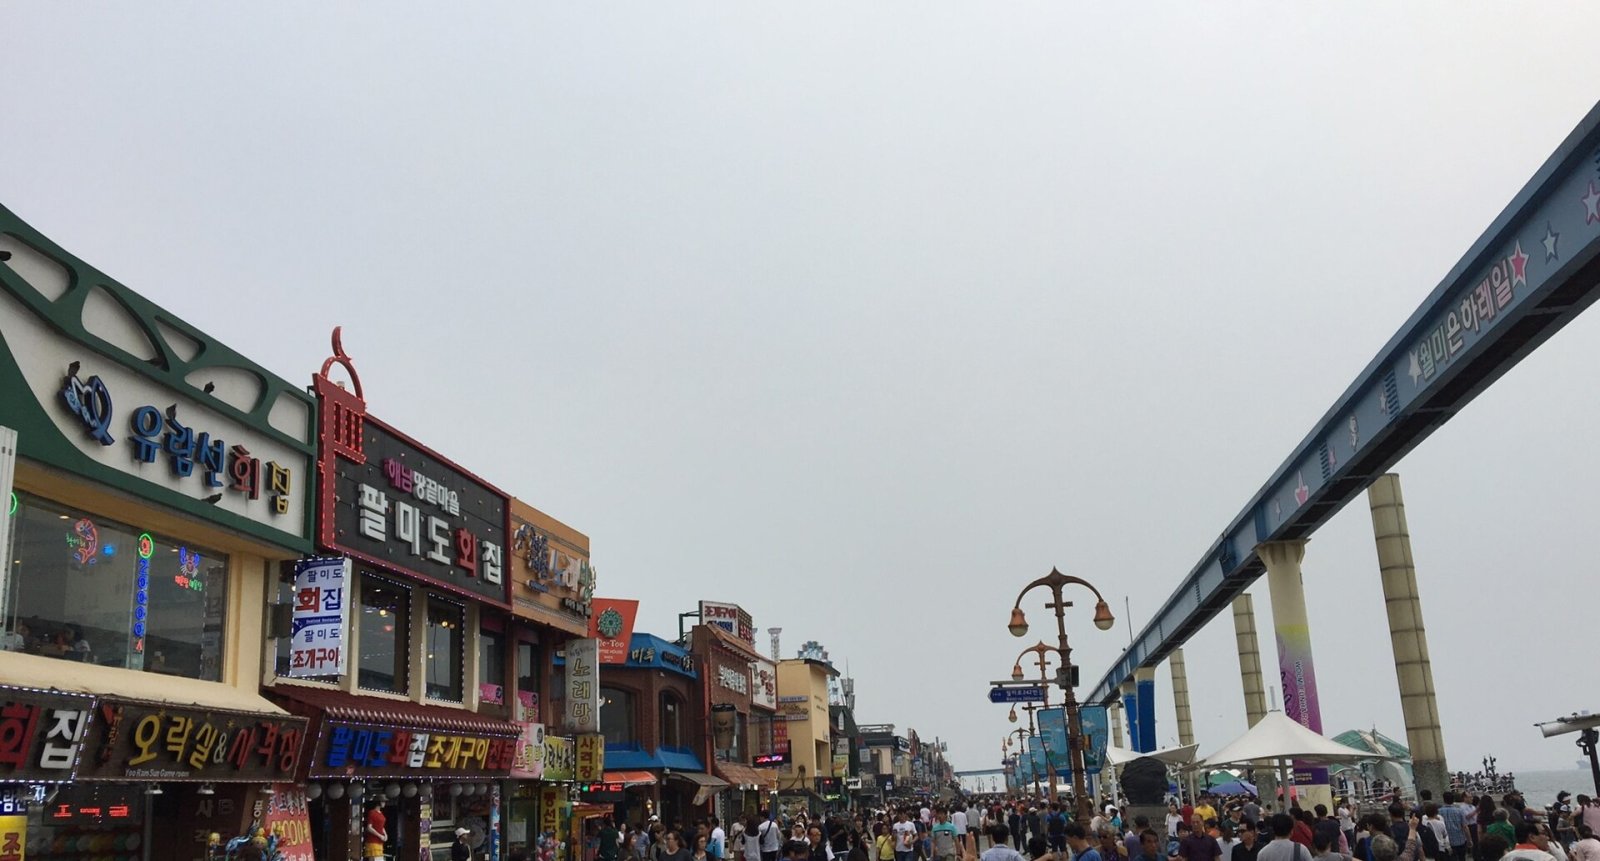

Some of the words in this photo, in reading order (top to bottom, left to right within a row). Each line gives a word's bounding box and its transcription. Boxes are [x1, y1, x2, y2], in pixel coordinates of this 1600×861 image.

[1419, 258, 1514, 381] 월미은하레일
[307, 568, 342, 582] 팔미도
[295, 586, 341, 613] 회집
[304, 627, 339, 643] 팔미도
[293, 646, 339, 670] 조개구이
[572, 657, 592, 725] 노래방
